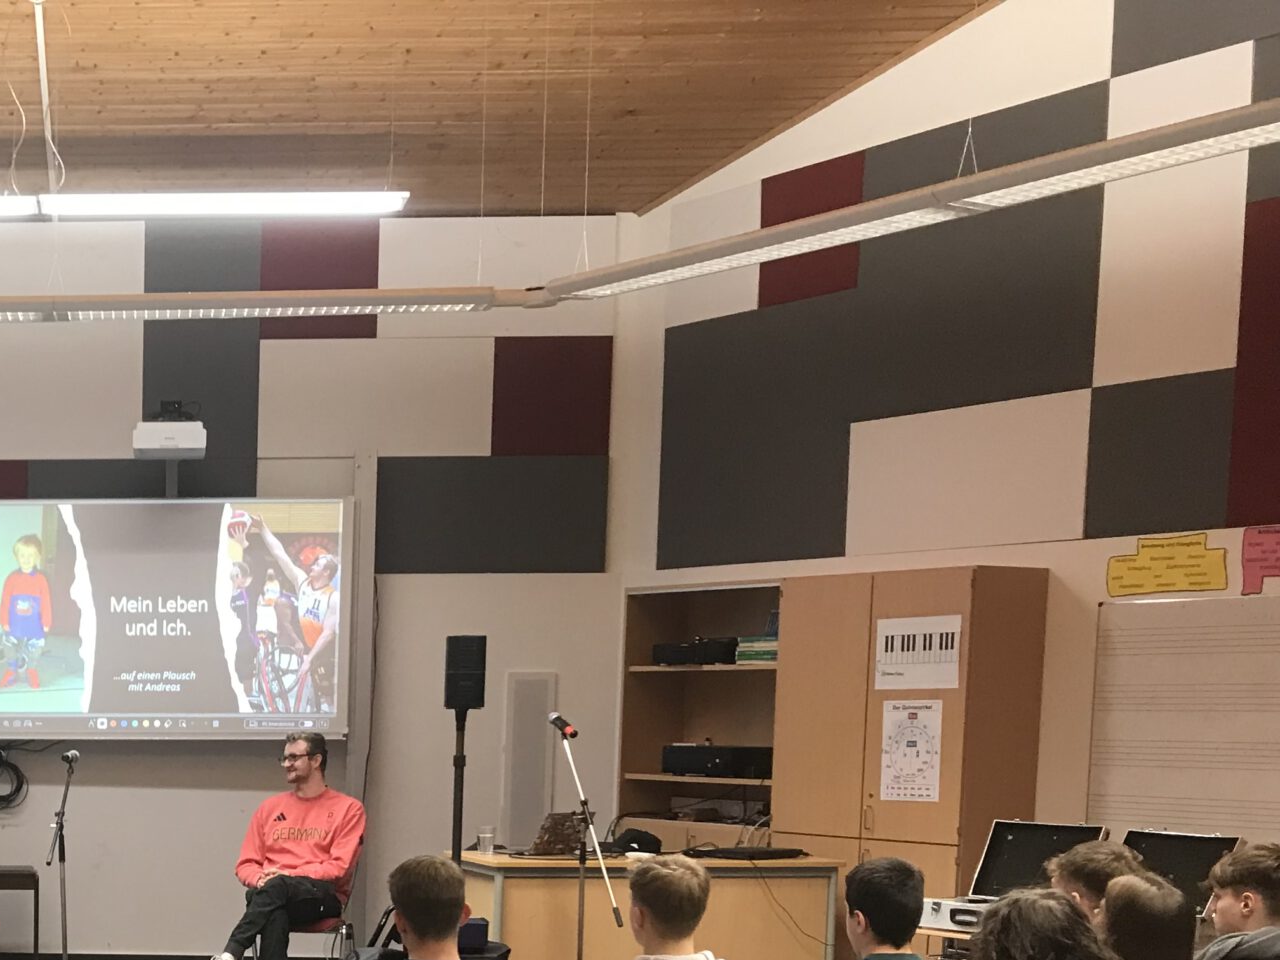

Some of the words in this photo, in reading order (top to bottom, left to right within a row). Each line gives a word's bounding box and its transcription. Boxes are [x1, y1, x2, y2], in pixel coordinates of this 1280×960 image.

[110, 595, 152, 613] Mein
[158, 594, 208, 613] Leben
[125, 618, 157, 636] und
[163, 618, 192, 636] Ich.
[137, 671, 161, 680] einen
[162, 670, 196, 680] Plausch
[128, 682, 143, 692] mit
[144, 682, 181, 692] Andreas
[272, 826, 331, 842] GERMANY
